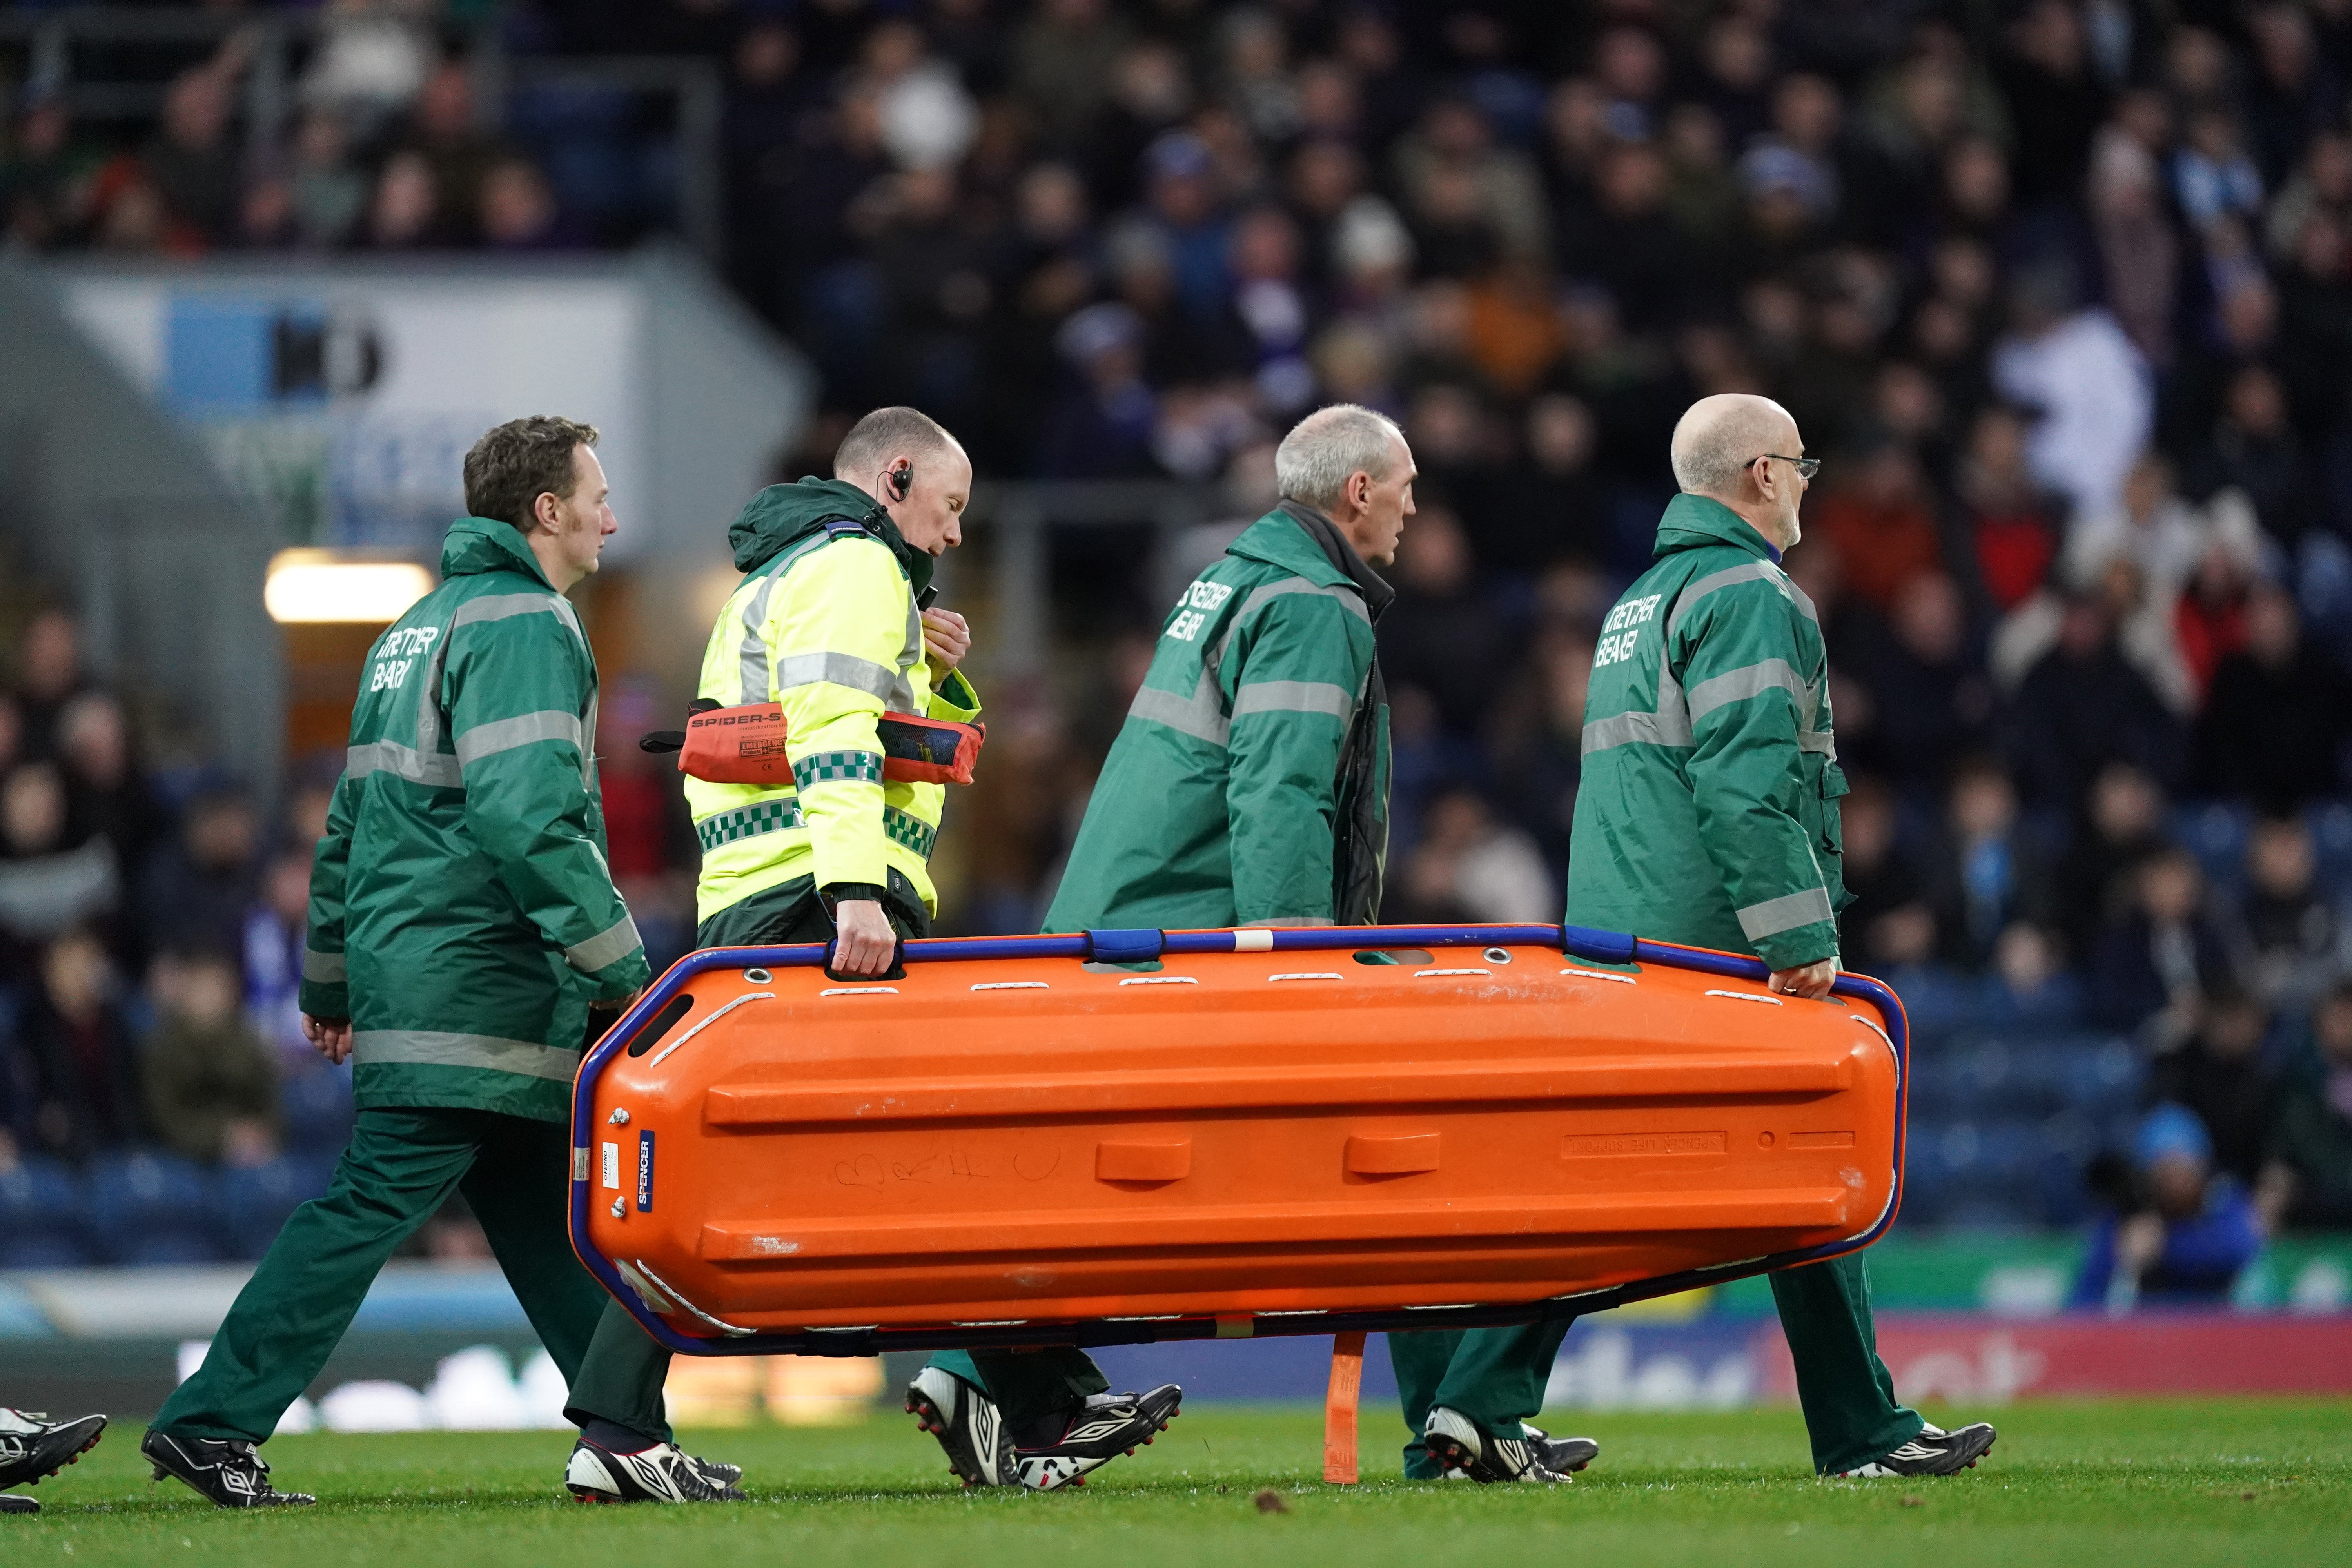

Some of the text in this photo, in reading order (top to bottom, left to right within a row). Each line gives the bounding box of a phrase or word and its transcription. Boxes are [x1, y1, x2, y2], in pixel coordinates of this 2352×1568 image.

[742, 739, 786, 749] EMERGENCY
[1571, 1137, 1717, 1152] SPENCER LIFE SUPPORT
[639, 1141, 649, 1205] SPENCER
